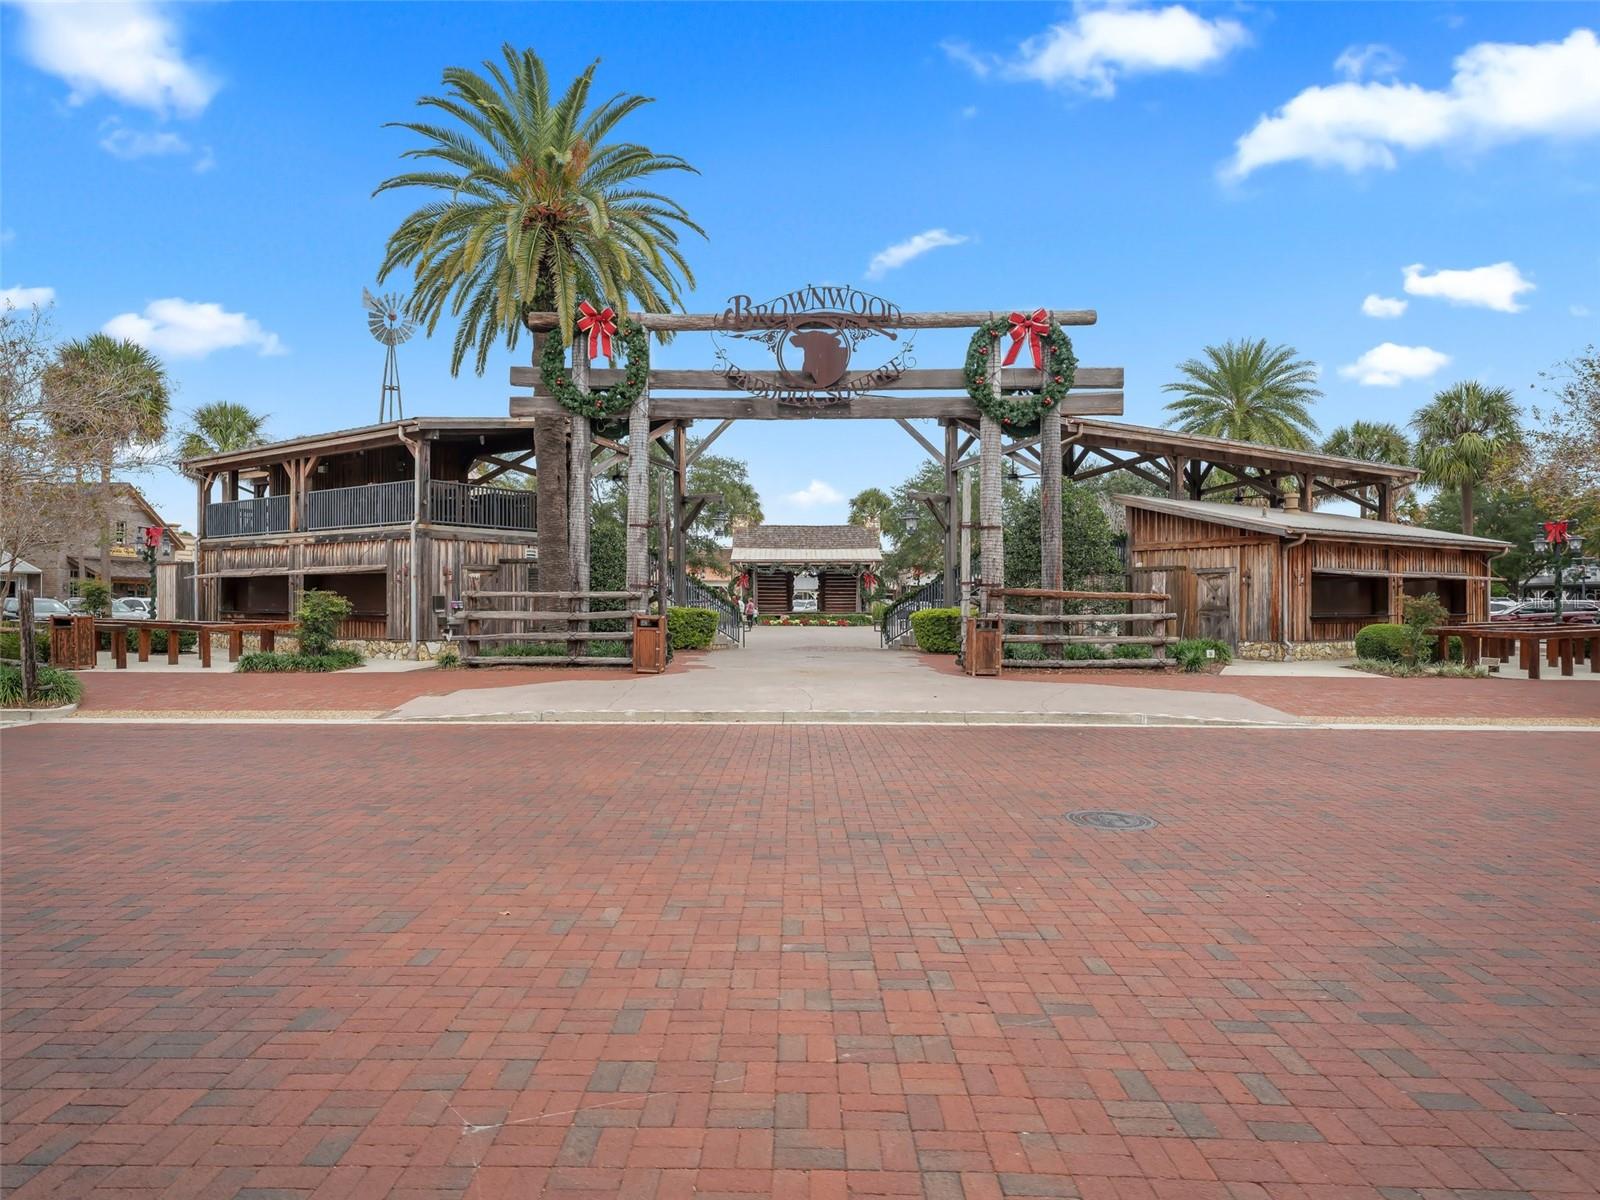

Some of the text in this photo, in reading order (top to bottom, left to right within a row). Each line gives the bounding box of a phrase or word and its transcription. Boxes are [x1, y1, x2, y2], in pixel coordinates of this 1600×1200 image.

[725, 284, 902, 328] BROWNWOOD
[725, 356, 906, 404] PADDOCK SQUARE
